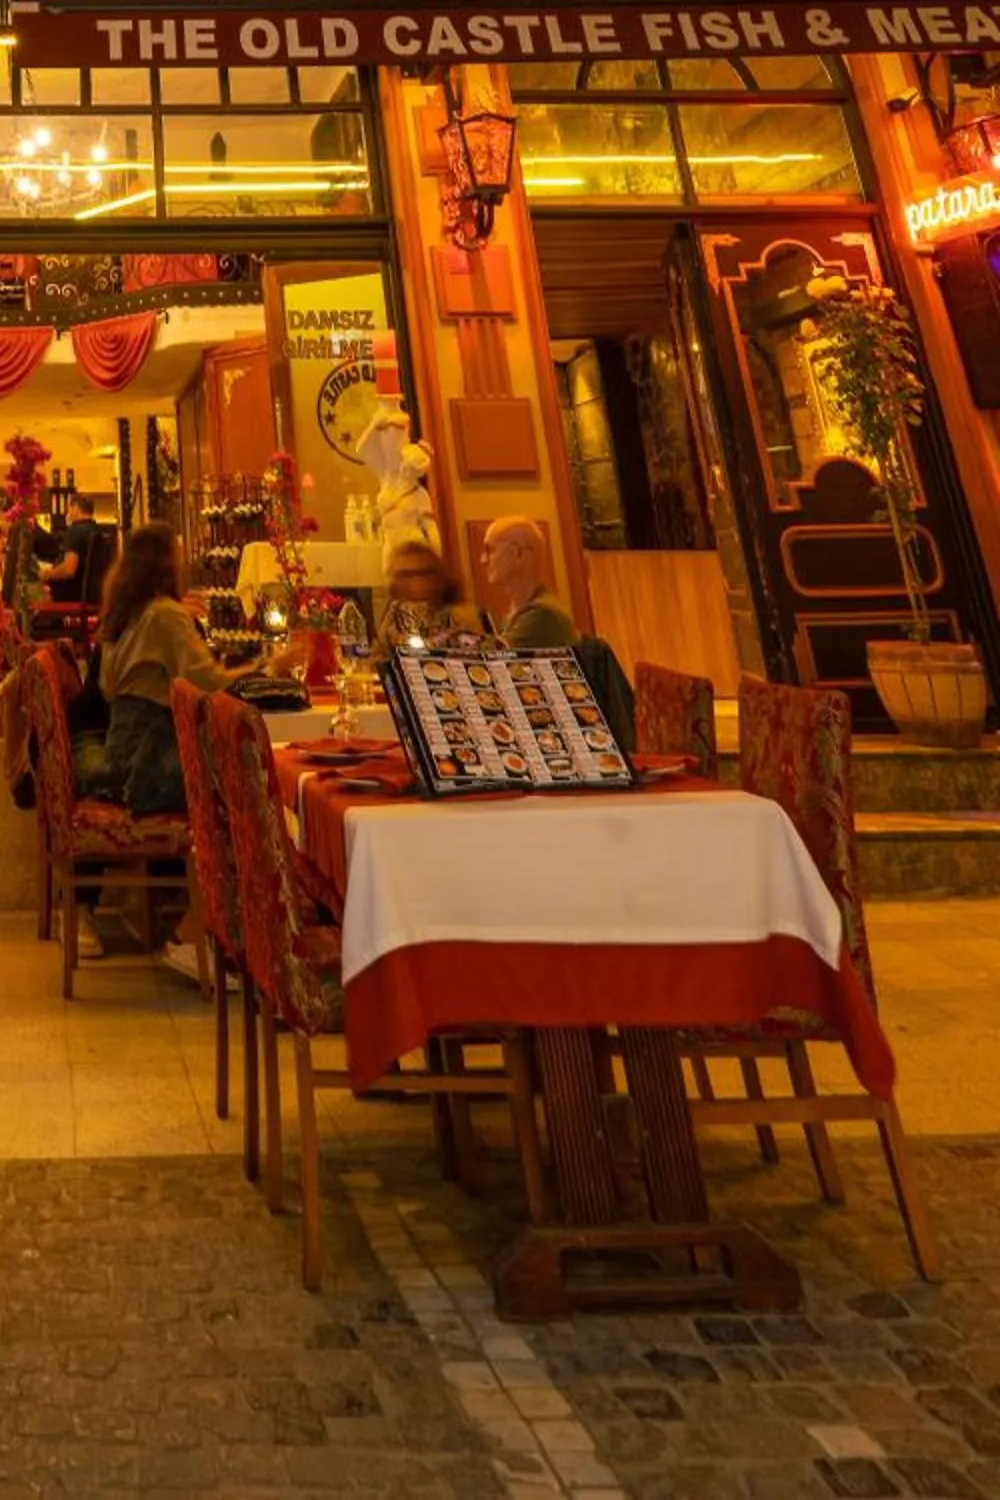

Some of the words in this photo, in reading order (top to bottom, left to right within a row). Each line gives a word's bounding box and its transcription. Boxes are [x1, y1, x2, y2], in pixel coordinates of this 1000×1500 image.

[96, 18, 219, 60] THE
[240, 17, 359, 59] OLD
[383, 14, 621, 56] CASTLE
[642, 11, 785, 51] FISH
[805, 9, 849, 46] &
[866, 5, 1000, 44] MEA
[288, 310, 376, 330] DAMSIZ
